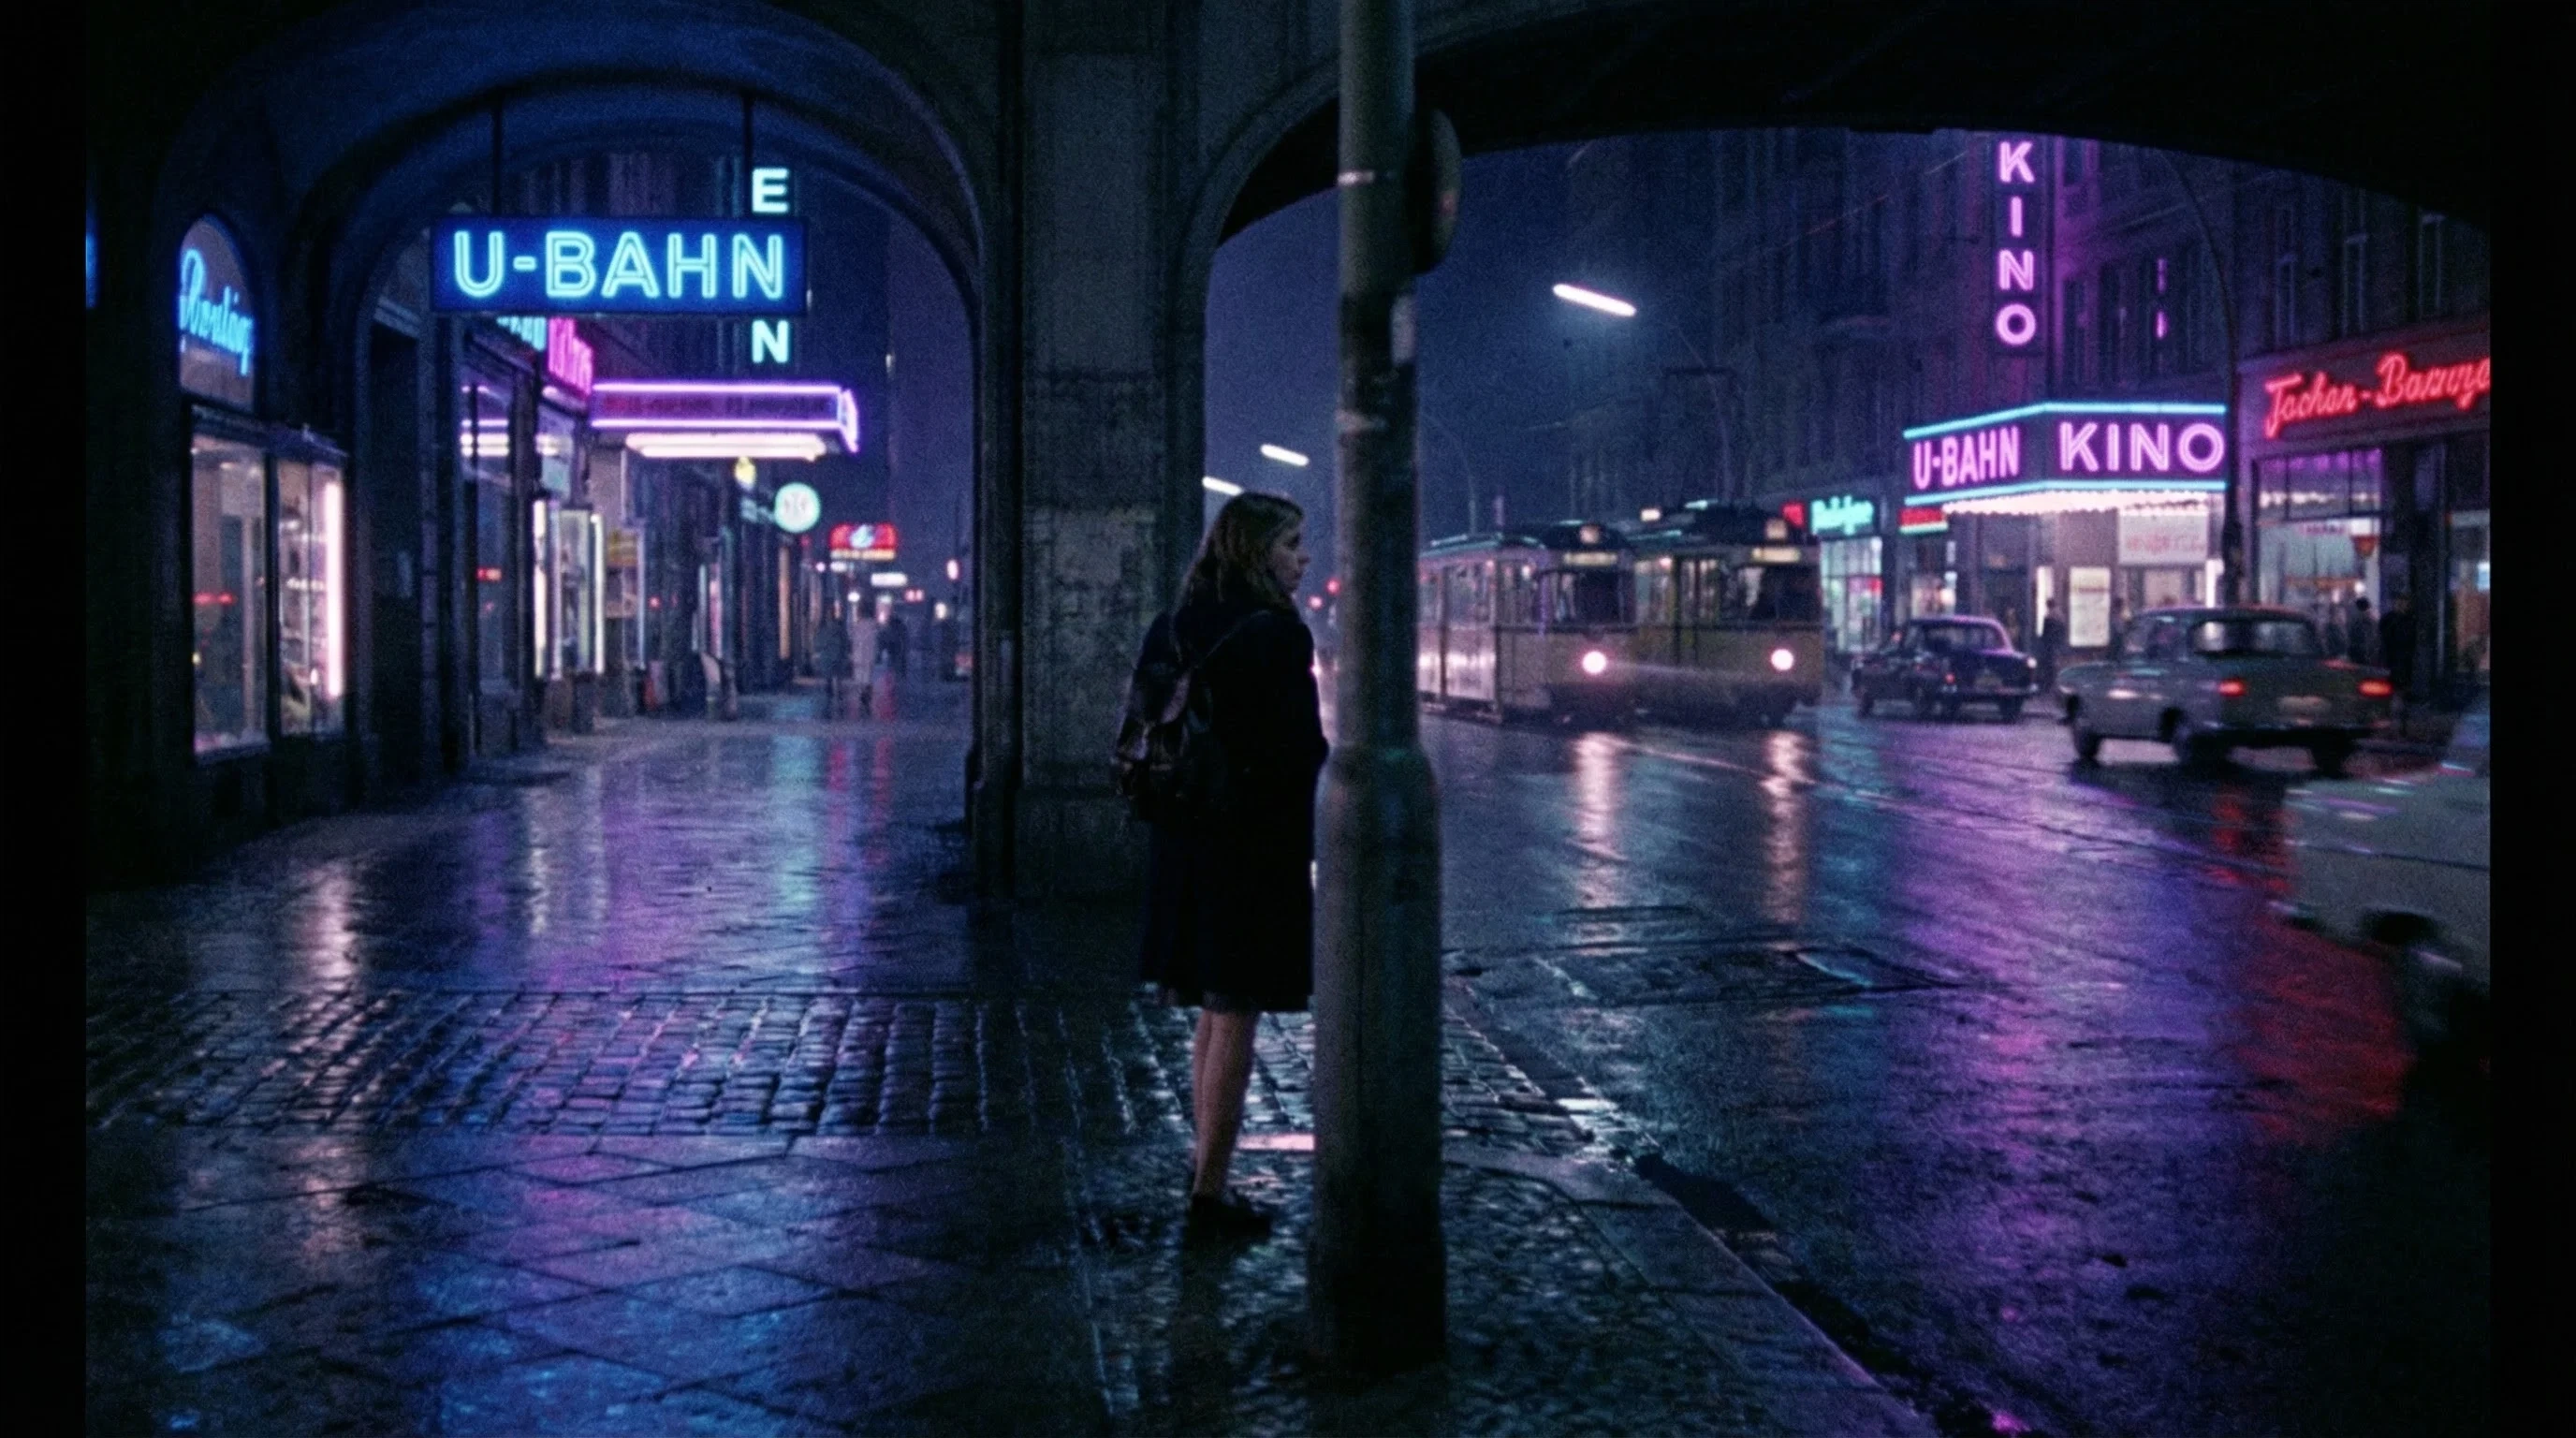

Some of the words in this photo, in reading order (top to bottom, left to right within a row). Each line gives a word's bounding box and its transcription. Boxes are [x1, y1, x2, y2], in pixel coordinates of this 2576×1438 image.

[453, 229, 784, 300] U-BAHN
[1996, 140, 2036, 345] KINO
[1913, 426, 2019, 491] U-BAHN
[2060, 421, 2225, 473] KINO
